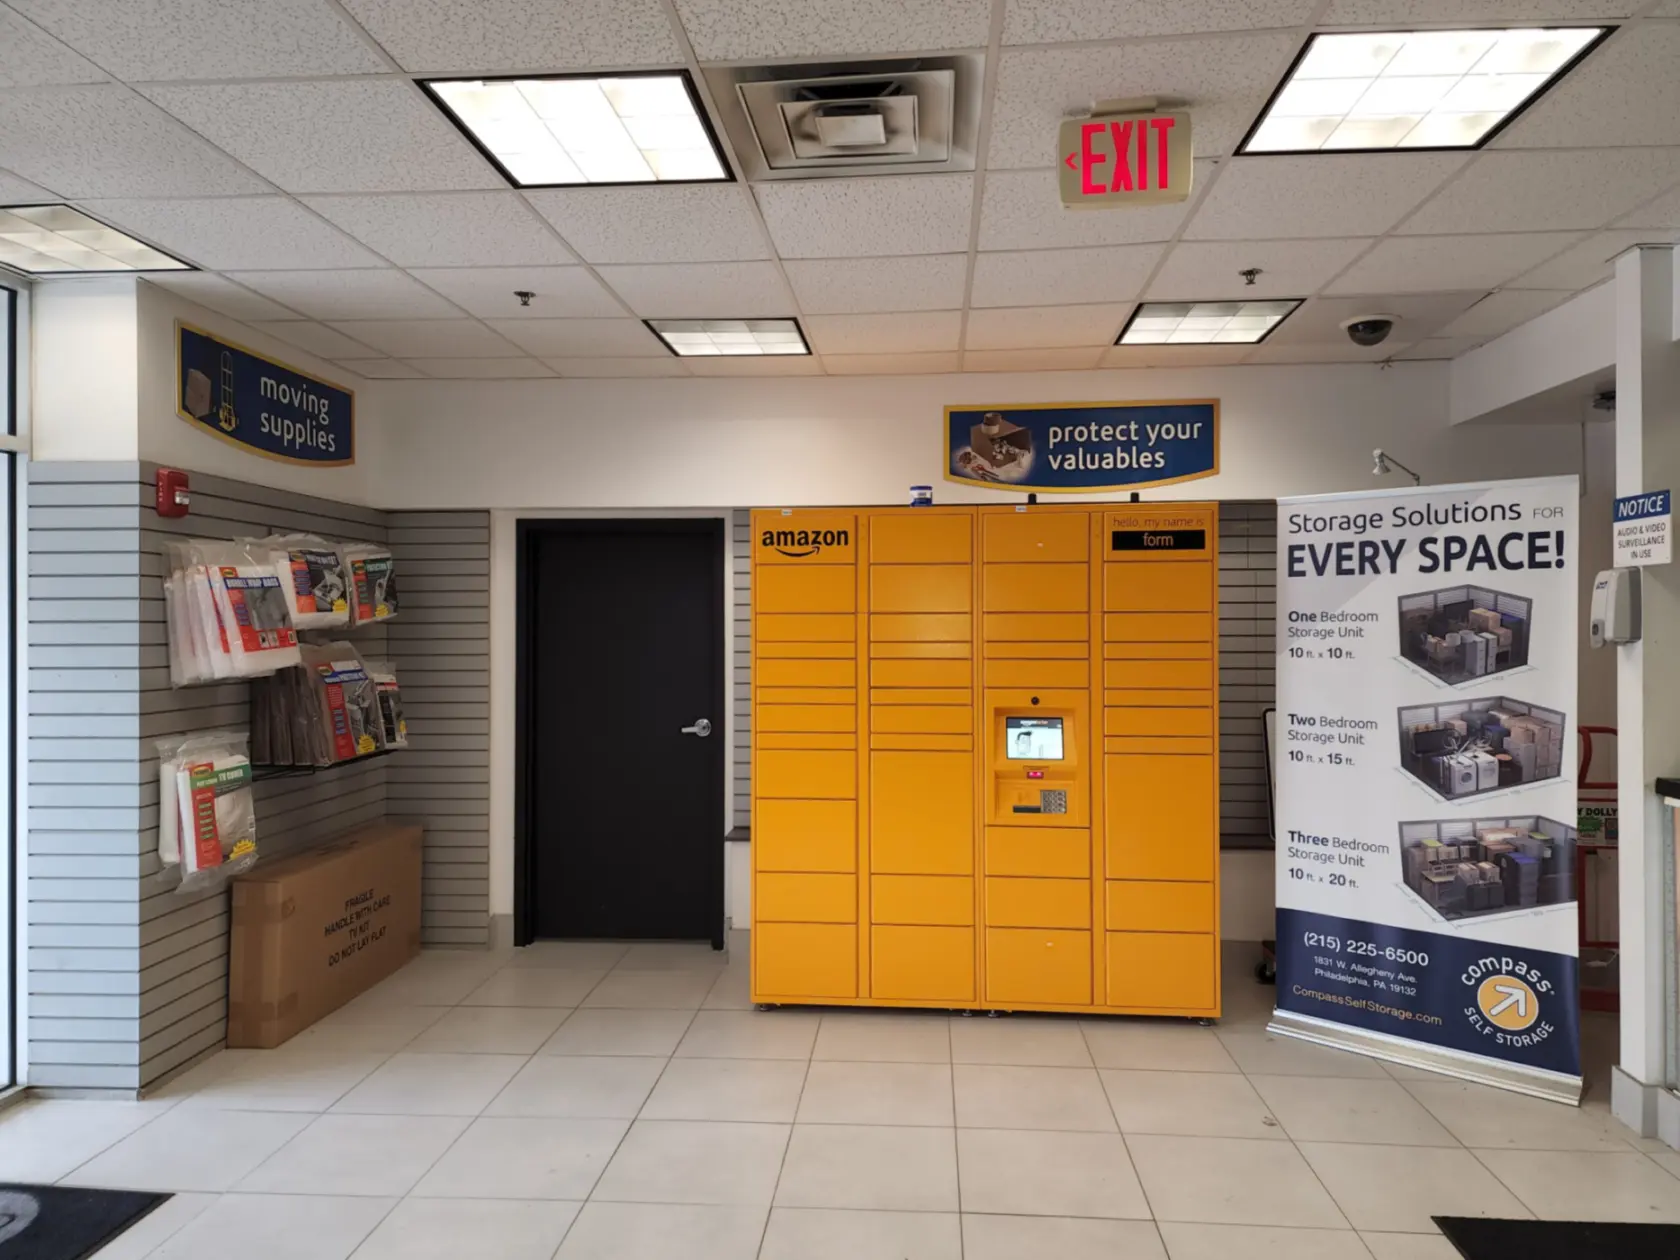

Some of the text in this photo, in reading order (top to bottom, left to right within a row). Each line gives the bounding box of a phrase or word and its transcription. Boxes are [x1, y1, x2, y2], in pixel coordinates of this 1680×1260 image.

[1081, 117, 1176, 195] EXIT
[260, 376, 329, 425] moving
[260, 412, 335, 452] supplies
[1048, 421, 1202, 448] protect your
[1048, 446, 1166, 470] valuables
[1288, 501, 1564, 534] Storage Solutions FOR
[1618, 495, 1664, 518] NOTICE
[1144, 518, 1160, 528] my
[1164, 518, 1193, 526] name
[1196, 516, 1204, 526] is
[1617, 522, 1666, 536] AUDIO & VIDEO
[762, 530, 848, 546] amazon
[1142, 532, 1174, 546] form
[1618, 534, 1665, 549] SURVEILLANCE
[1288, 530, 1564, 577] EVERY SPACE!
[1630, 549, 1652, 559] IN USE
[1288, 610, 1378, 622] One Bedroom
[1288, 626, 1364, 640] Storage Unit
[1288, 647, 1304, 658] 10
[1306, 650, 1315, 658] ft.
[1327, 647, 1342, 659] 10
[1345, 651, 1355, 659] ft.
[1288, 713, 1378, 730] Two Bedroom
[1288, 729, 1365, 745] Storage Unit
[1288, 750, 1304, 762] 10
[1306, 754, 1315, 763] ft.
[1327, 752, 1343, 765] 15
[1345, 757, 1355, 765] ft.
[1586, 808, 1618, 816] DOLLY
[1288, 830, 1390, 854] Three Bedroom
[1288, 846, 1365, 867] Storage Unit
[1288, 868, 1304, 880] 10
[1329, 873, 1346, 886] 20
[1348, 879, 1359, 889] ft.
[344, 888, 374, 912] FRAGILE
[324, 894, 391, 938] HANDLE WITH CARE
[328, 926, 387, 967] DO NOT LAY FLAT
[1304, 932, 1429, 966] (215) 225-6500
[1314, 956, 1418, 983] 1831 W. Allegheny Ave.
[1461, 956, 1552, 992] compass
[1314, 968, 1416, 996] Philadelphia, PA 19132
[1292, 984, 1442, 1025] CompassSelfStorage.com
[1464, 1006, 1554, 1047] SELF STORAGE
